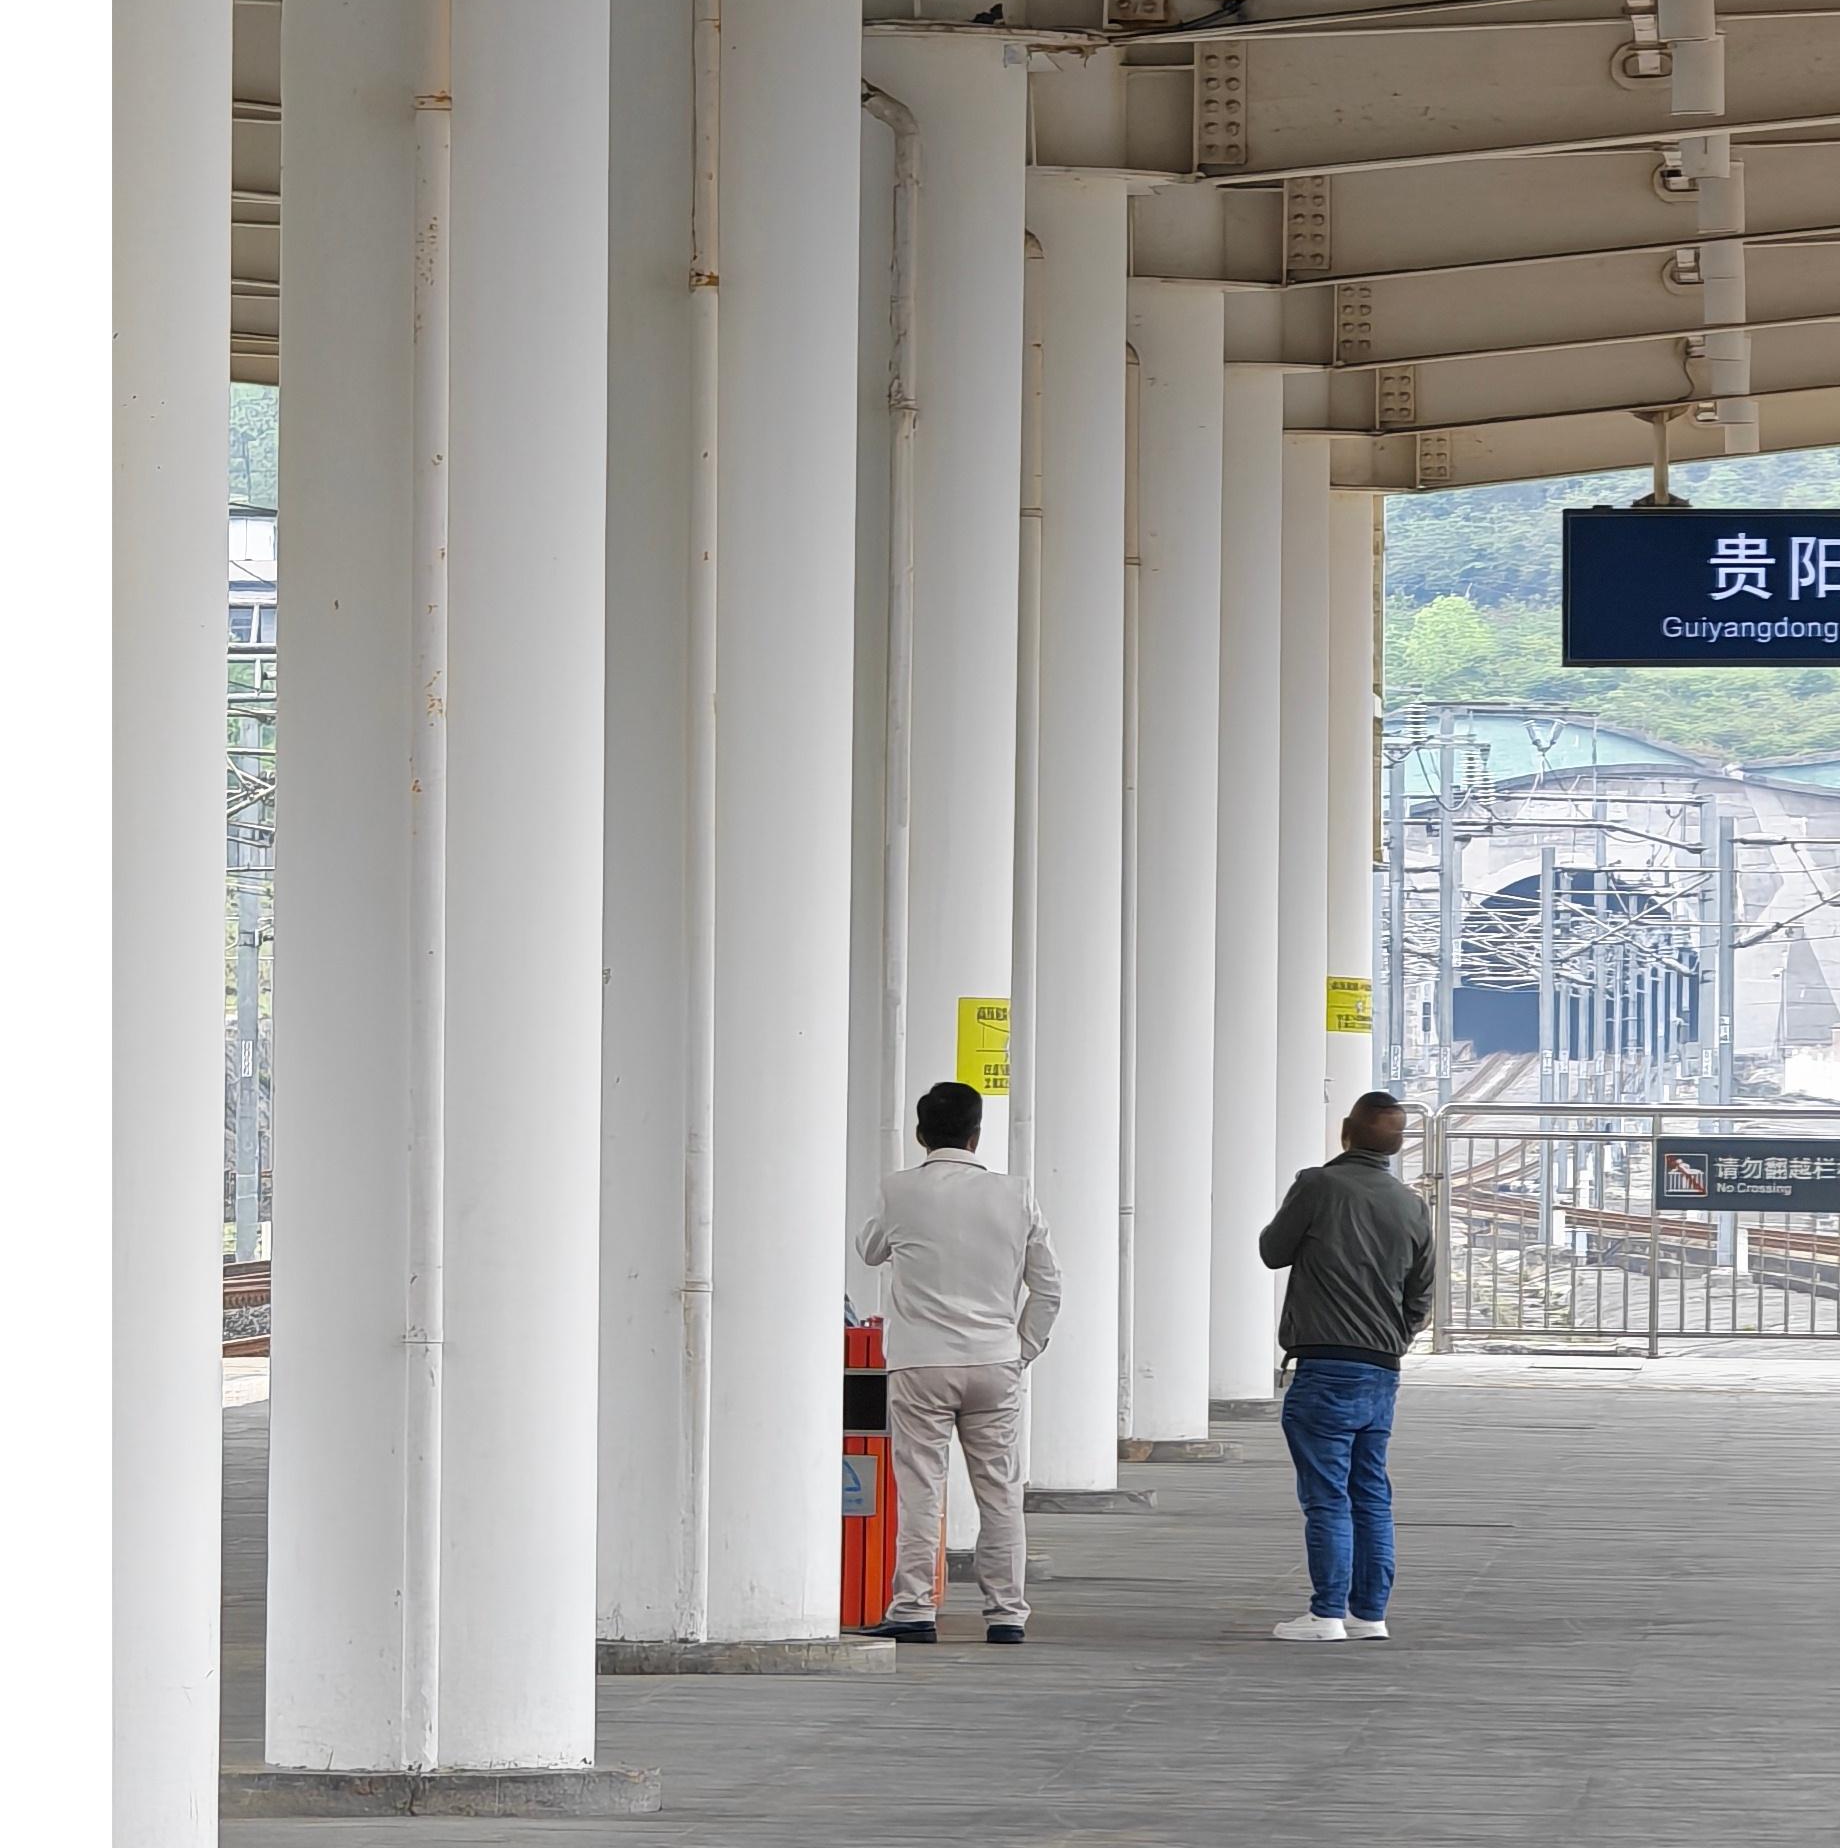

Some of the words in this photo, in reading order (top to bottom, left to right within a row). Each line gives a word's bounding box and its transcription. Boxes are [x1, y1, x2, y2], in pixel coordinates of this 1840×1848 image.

[1662, 616, 1839, 643] Guiyangdong
[1716, 1182, 1735, 1193] No
[1737, 1181, 1793, 1196] Crossing
